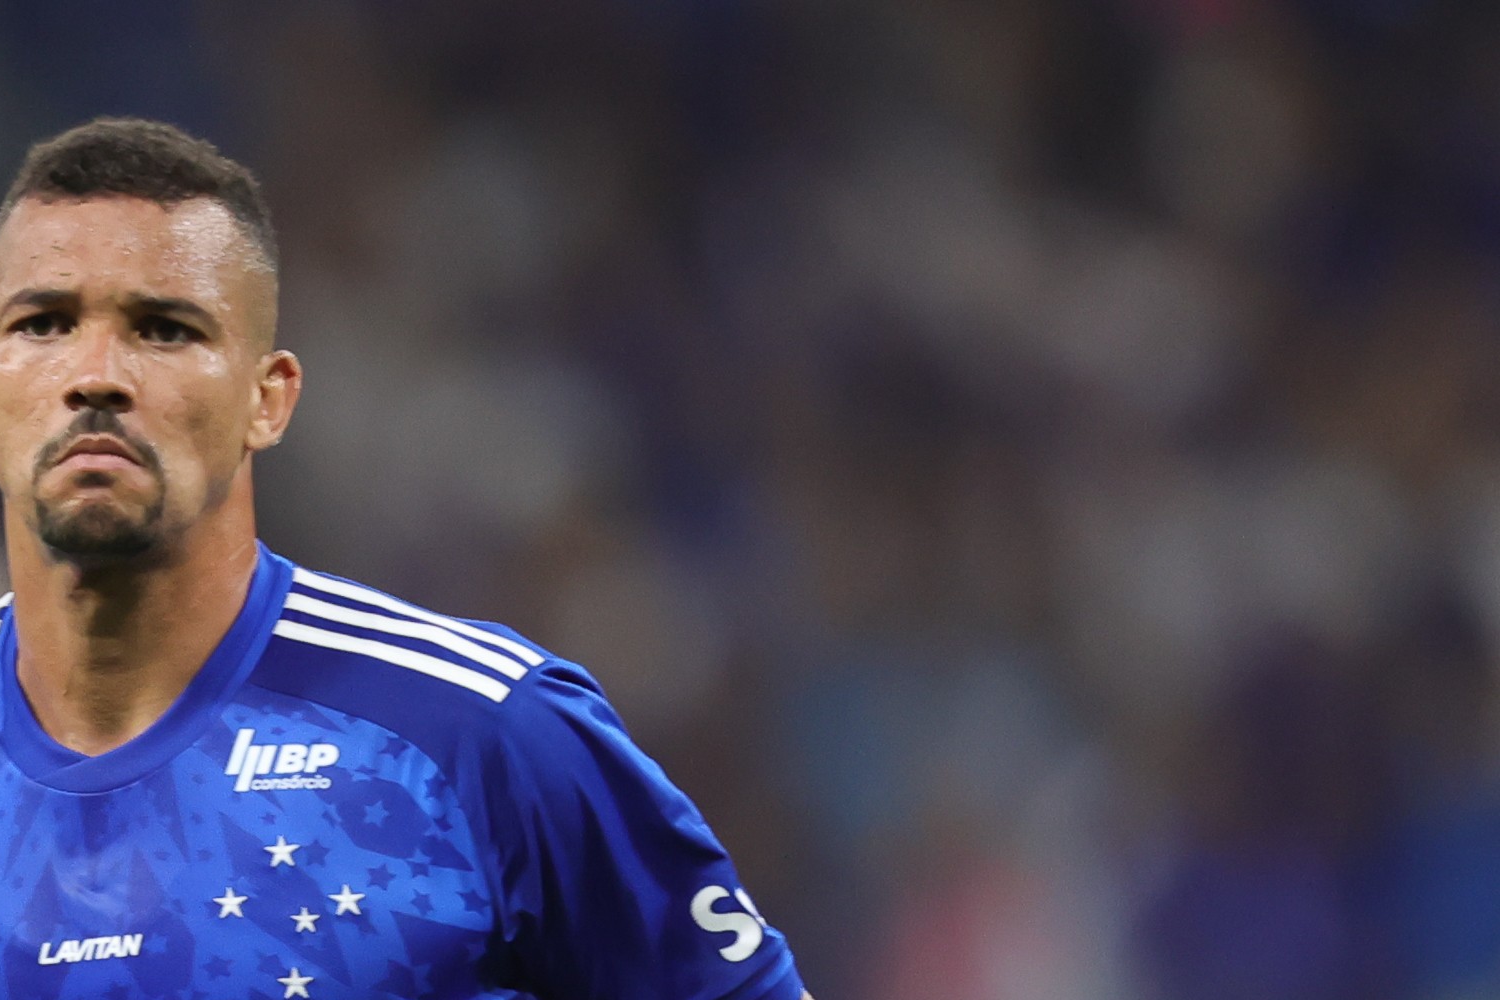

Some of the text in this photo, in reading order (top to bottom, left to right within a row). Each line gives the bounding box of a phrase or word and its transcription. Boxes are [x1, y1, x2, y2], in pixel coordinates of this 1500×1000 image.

[274, 743, 340, 774] BP
[251, 774, 332, 791] consórcio
[690, 885, 767, 962] S
[38, 933, 144, 965] LAVITAN
